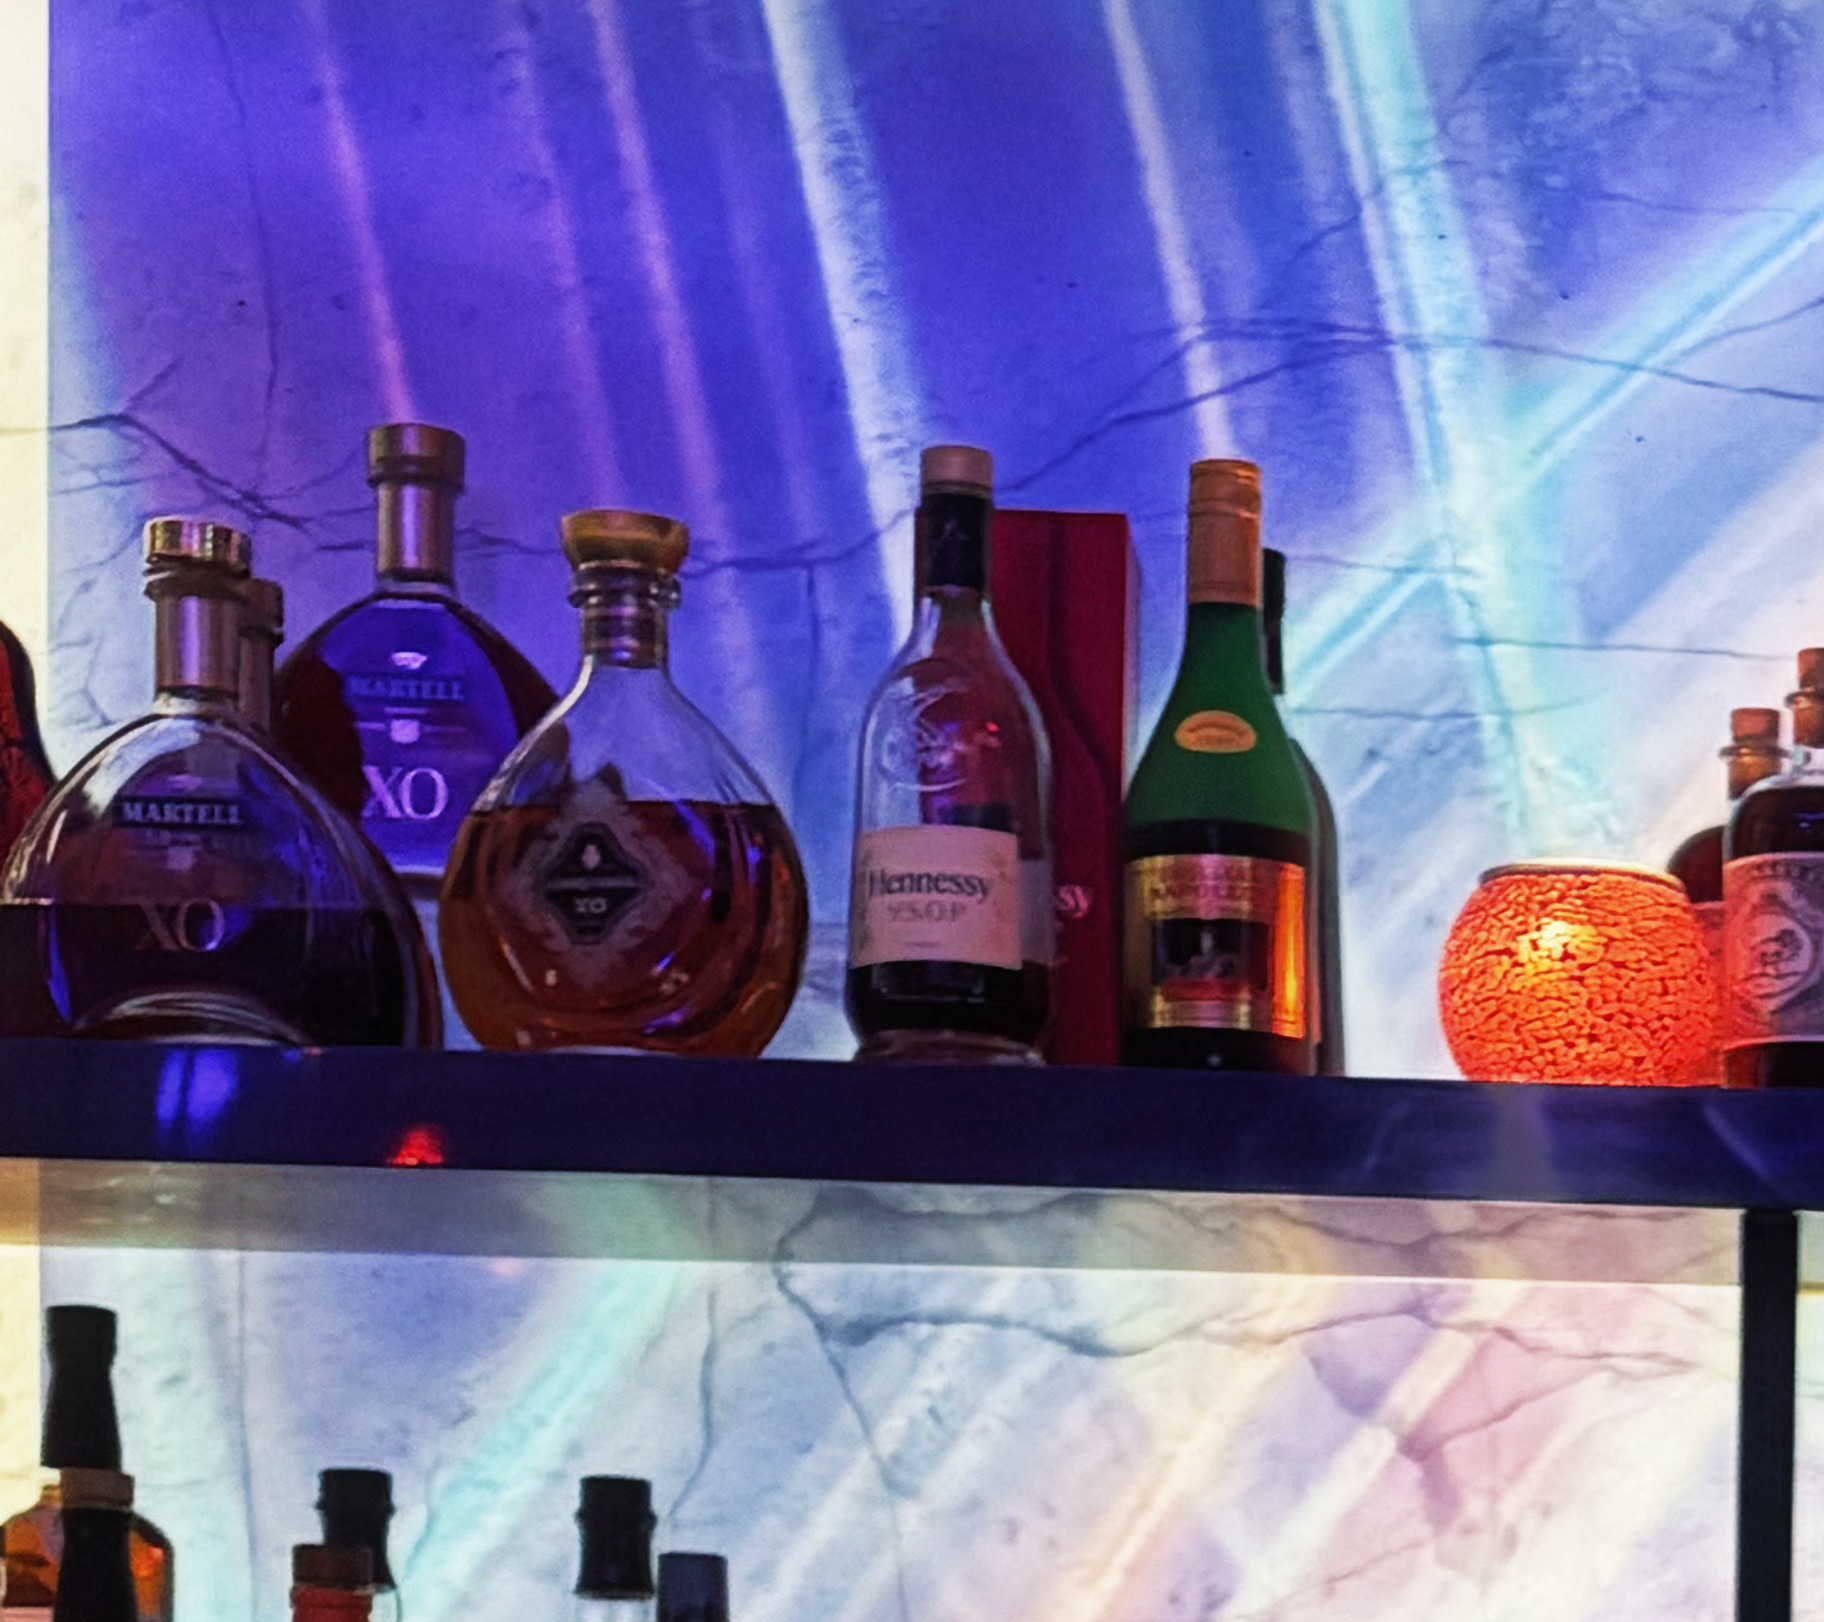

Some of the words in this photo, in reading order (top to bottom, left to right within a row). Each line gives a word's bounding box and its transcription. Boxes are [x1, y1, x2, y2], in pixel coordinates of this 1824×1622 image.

[121, 801, 243, 825] MARTELL
[363, 765, 449, 820] XO
[869, 868, 990, 904] Hennessy
[133, 899, 226, 951] XO
